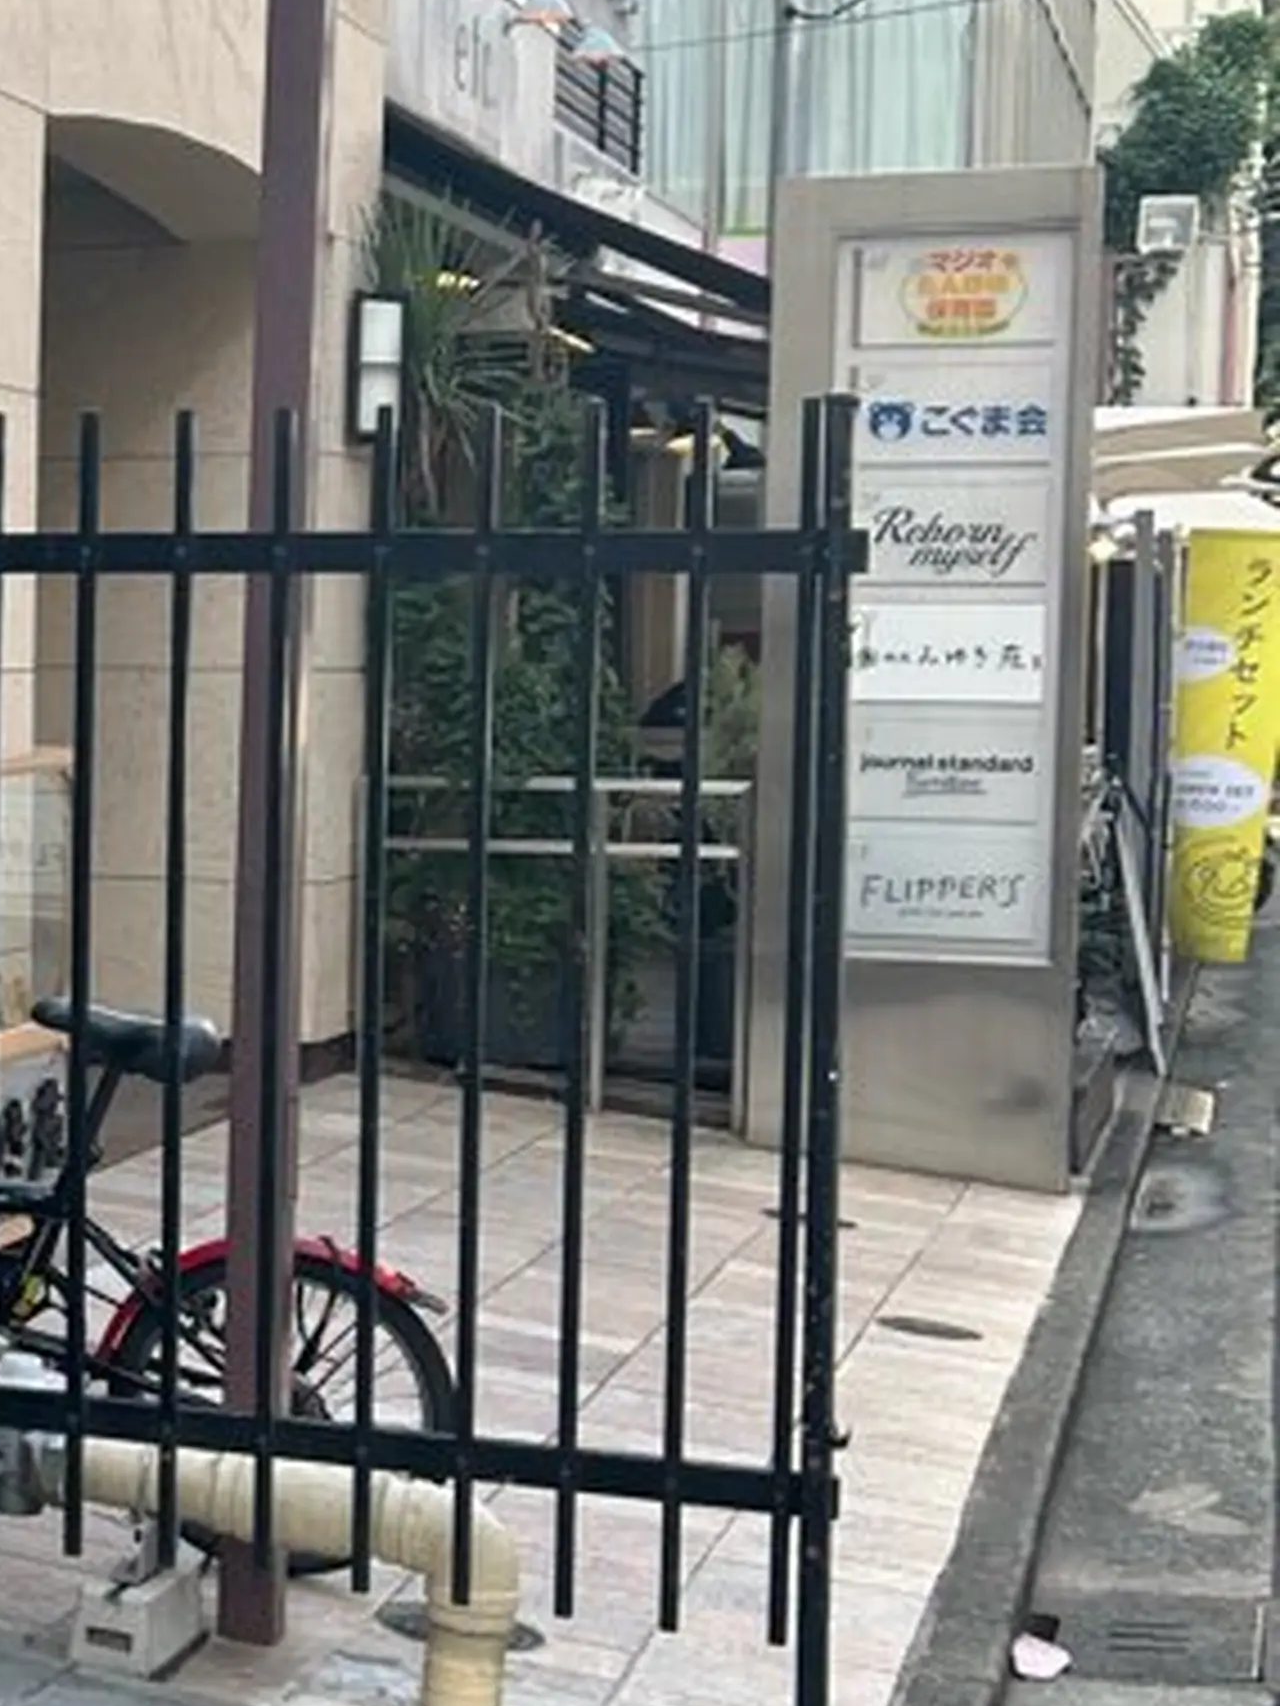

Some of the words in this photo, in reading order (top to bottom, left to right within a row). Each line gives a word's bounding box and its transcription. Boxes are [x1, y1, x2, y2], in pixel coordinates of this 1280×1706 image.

[920, 402, 1048, 437] こぐま会
[873, 504, 1005, 544] Reborn
[907, 530, 1038, 577] myself
[1224, 557, 1274, 751] ランチセット
[859, 873, 1026, 909] FLIPPER'S
